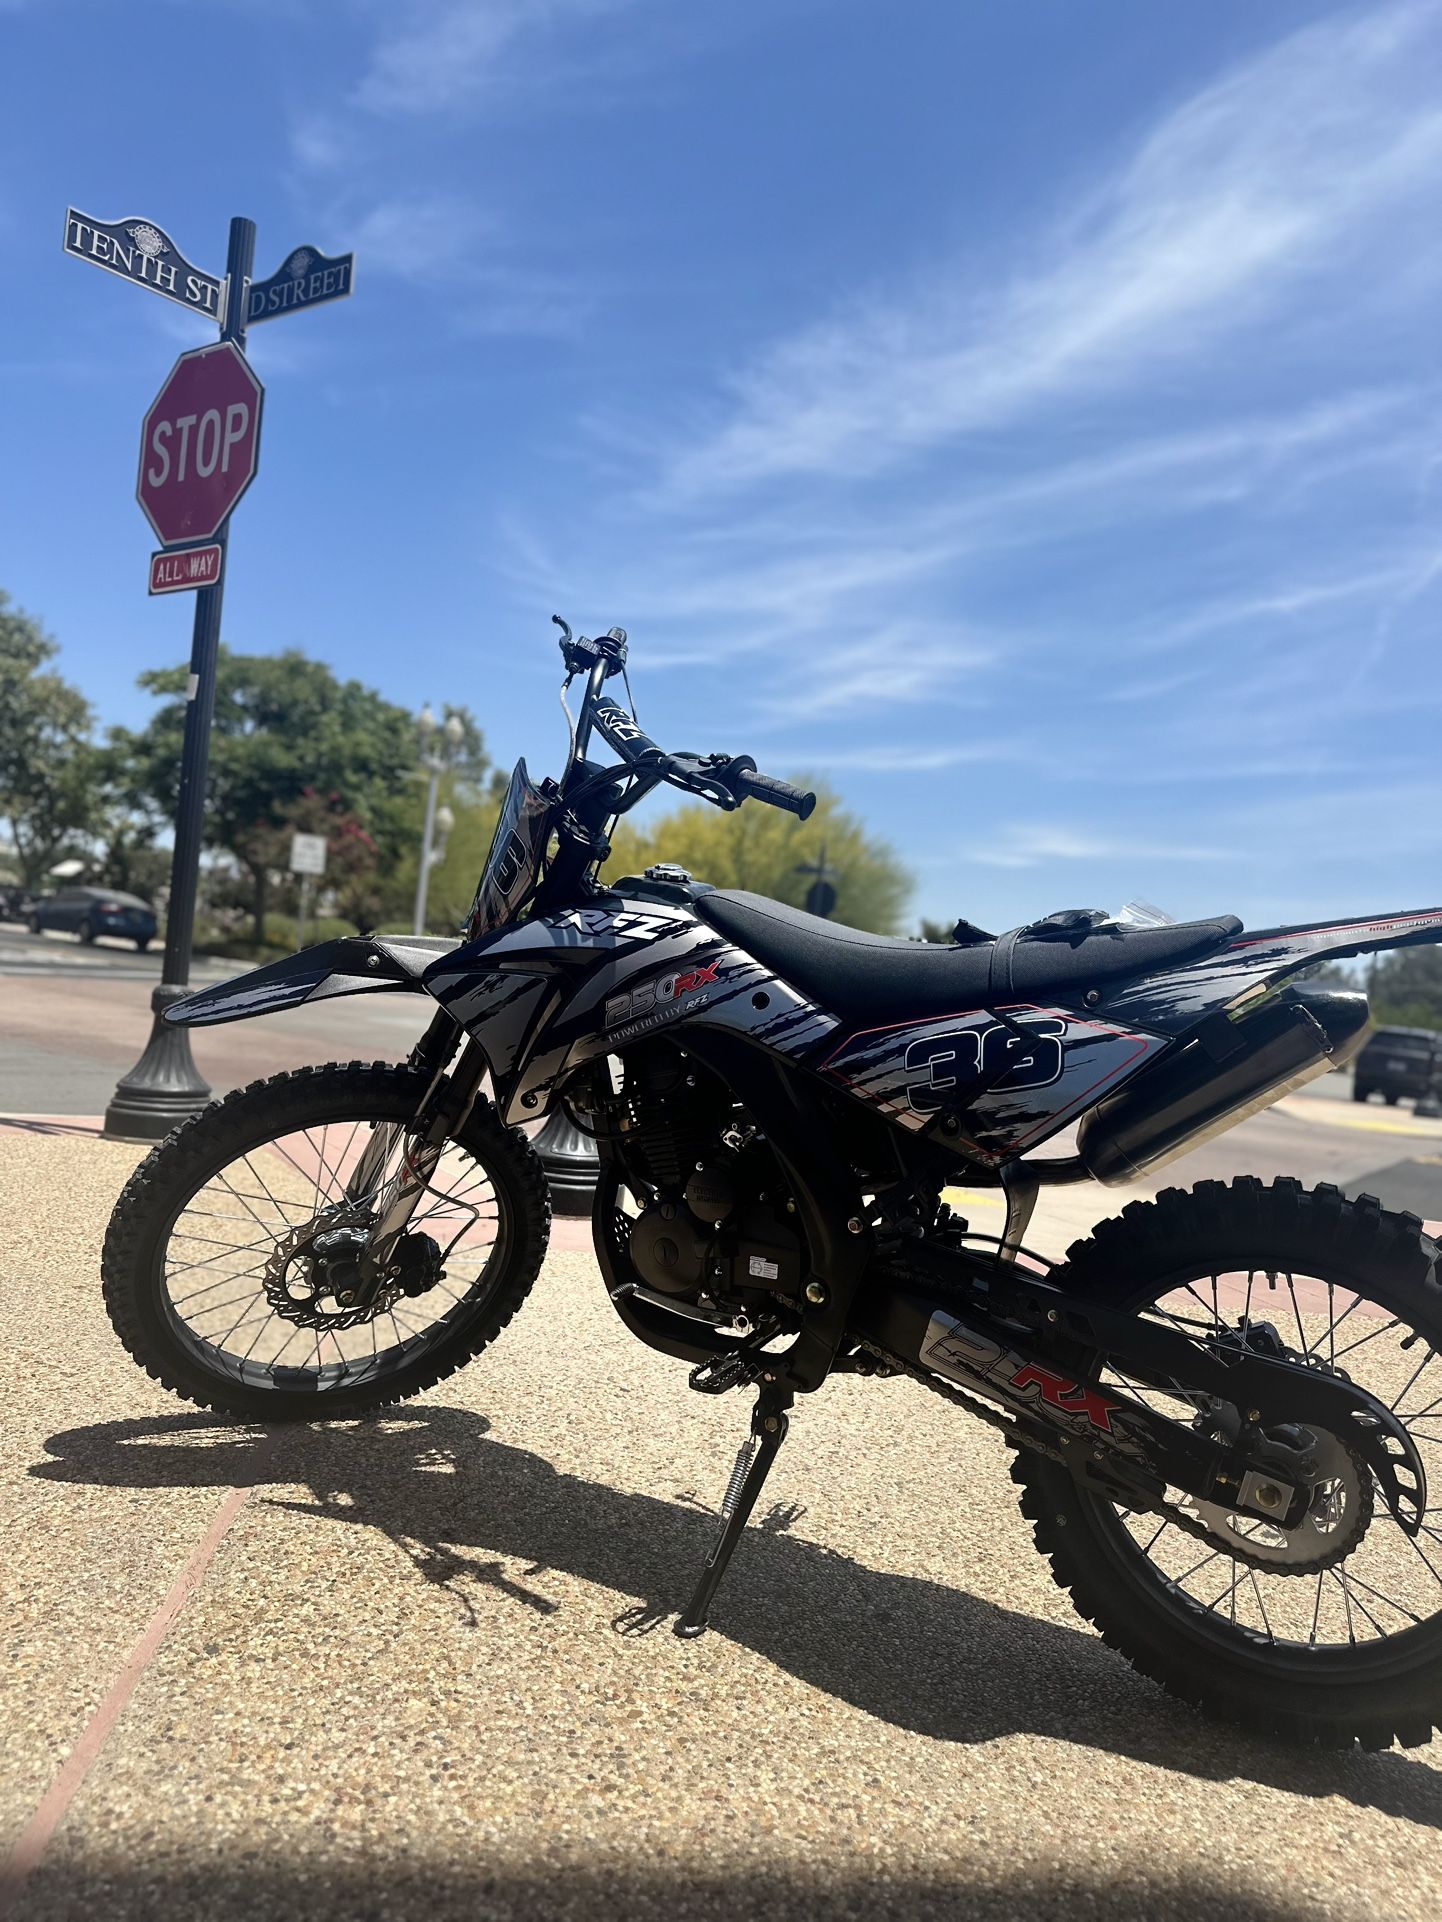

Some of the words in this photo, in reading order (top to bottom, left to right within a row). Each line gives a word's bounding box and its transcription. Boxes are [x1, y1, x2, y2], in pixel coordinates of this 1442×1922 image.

[69, 219, 179, 293] TENTH
[185, 275, 220, 311] ST
[249, 292, 265, 316] D
[268, 263, 349, 311] STREET
[148, 402, 249, 488] STOP
[156, 560, 182, 583] ALL
[190, 553, 215, 578] WAY
[684, 992, 710, 1011] RFZ
